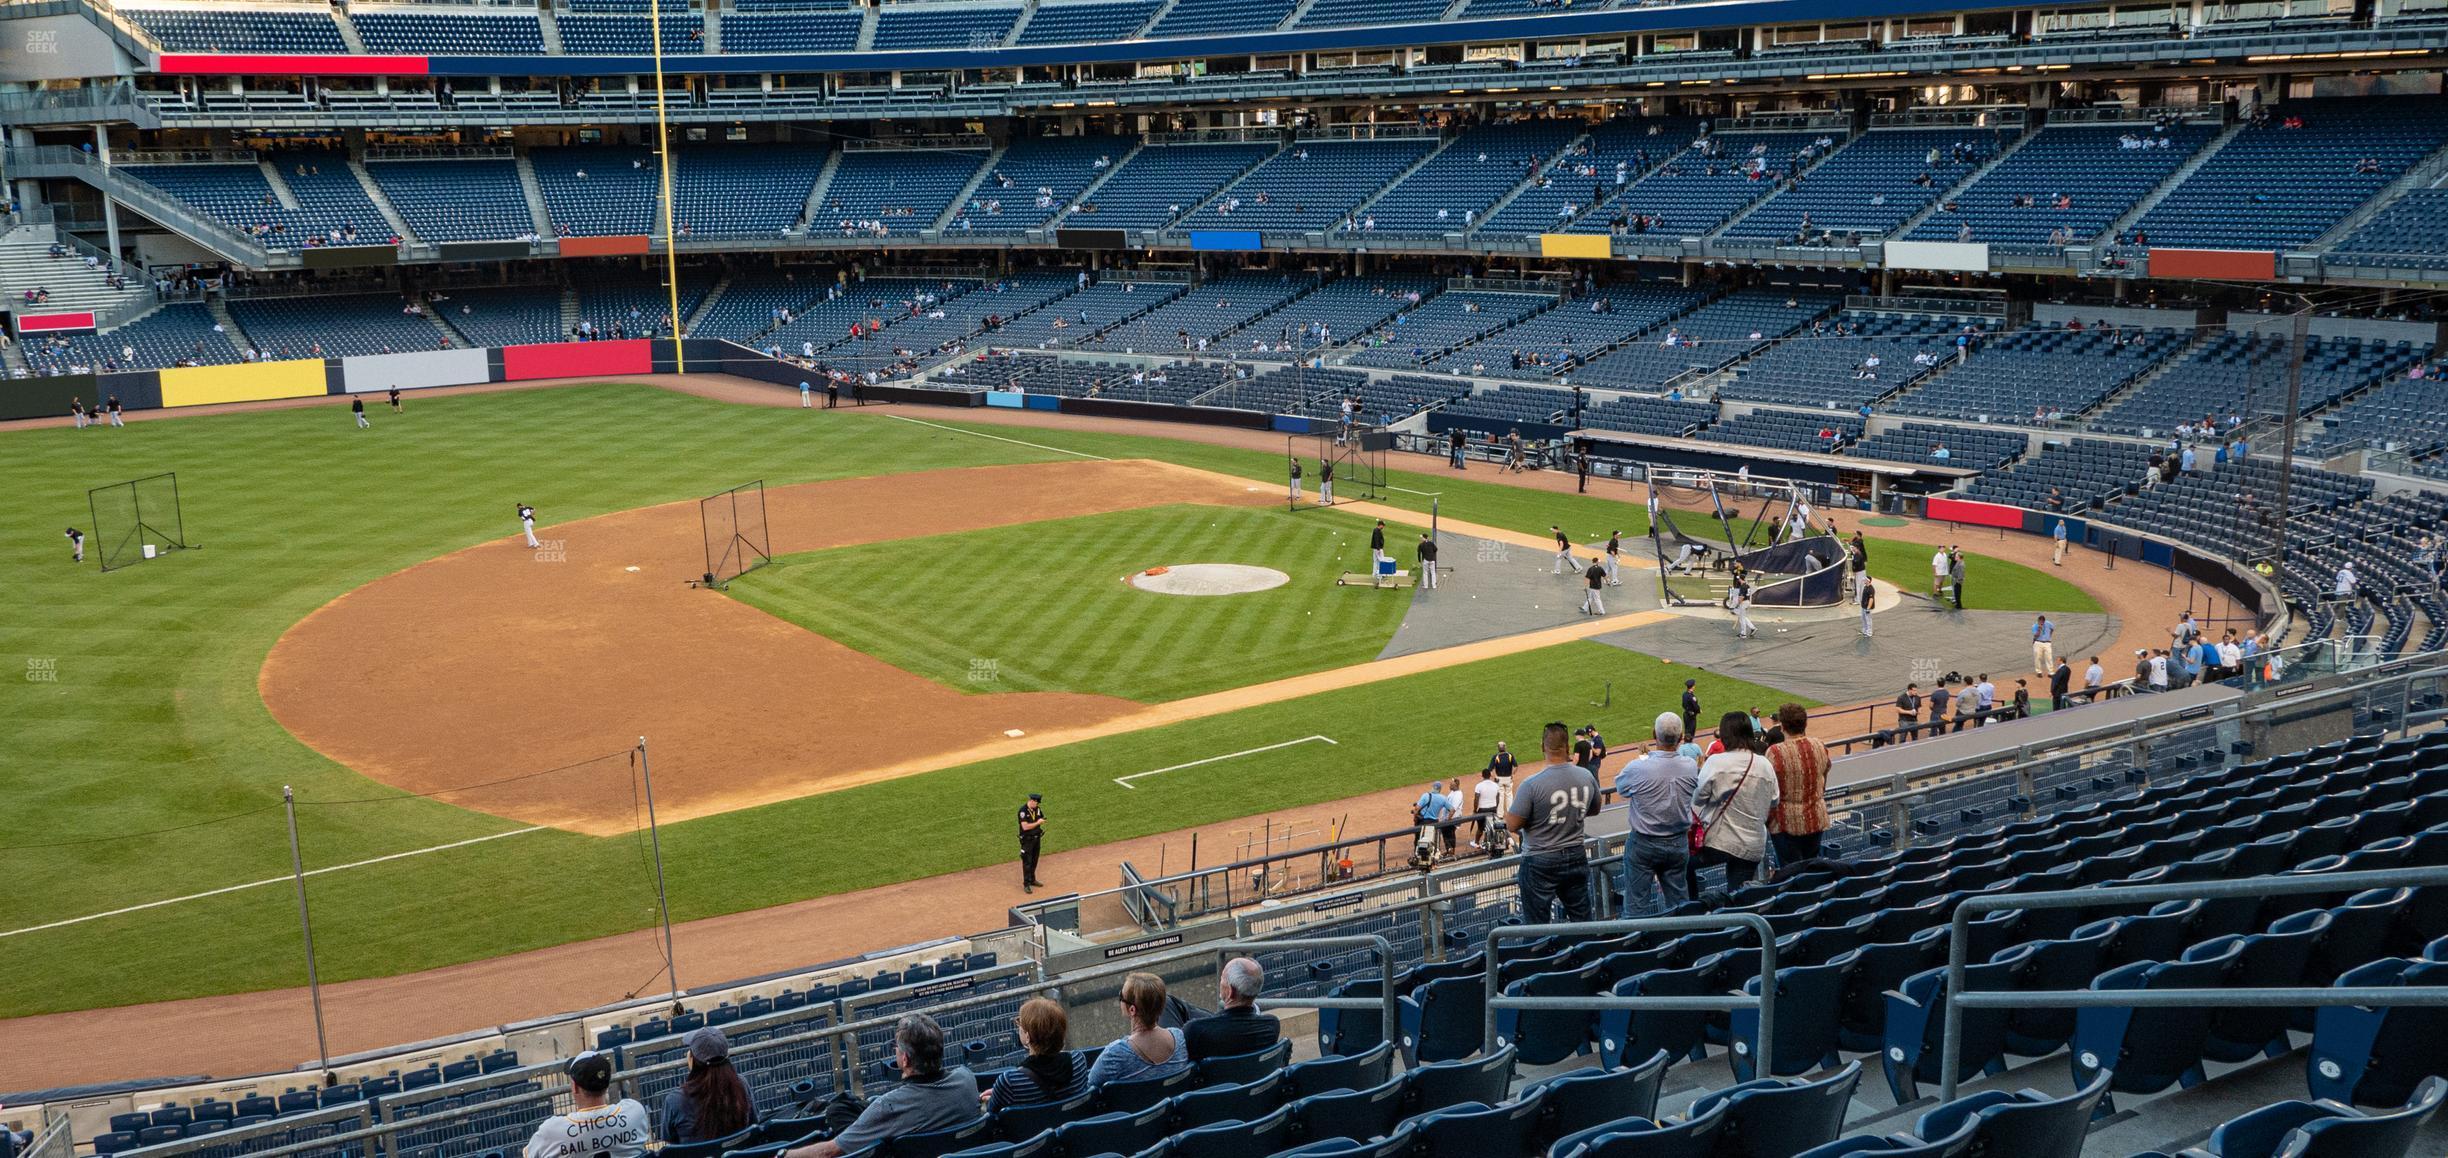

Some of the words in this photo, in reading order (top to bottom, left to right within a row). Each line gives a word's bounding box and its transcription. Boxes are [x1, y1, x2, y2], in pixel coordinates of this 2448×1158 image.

[2160, 661, 2165, 670] 2
[1549, 786, 1589, 824] 24
[1115, 946, 1128, 955] ALERT
[567, 1115, 626, 1137] CHICO'S
[560, 1141, 587, 1156] BAIL
[592, 1129, 638, 1148] BONDS
